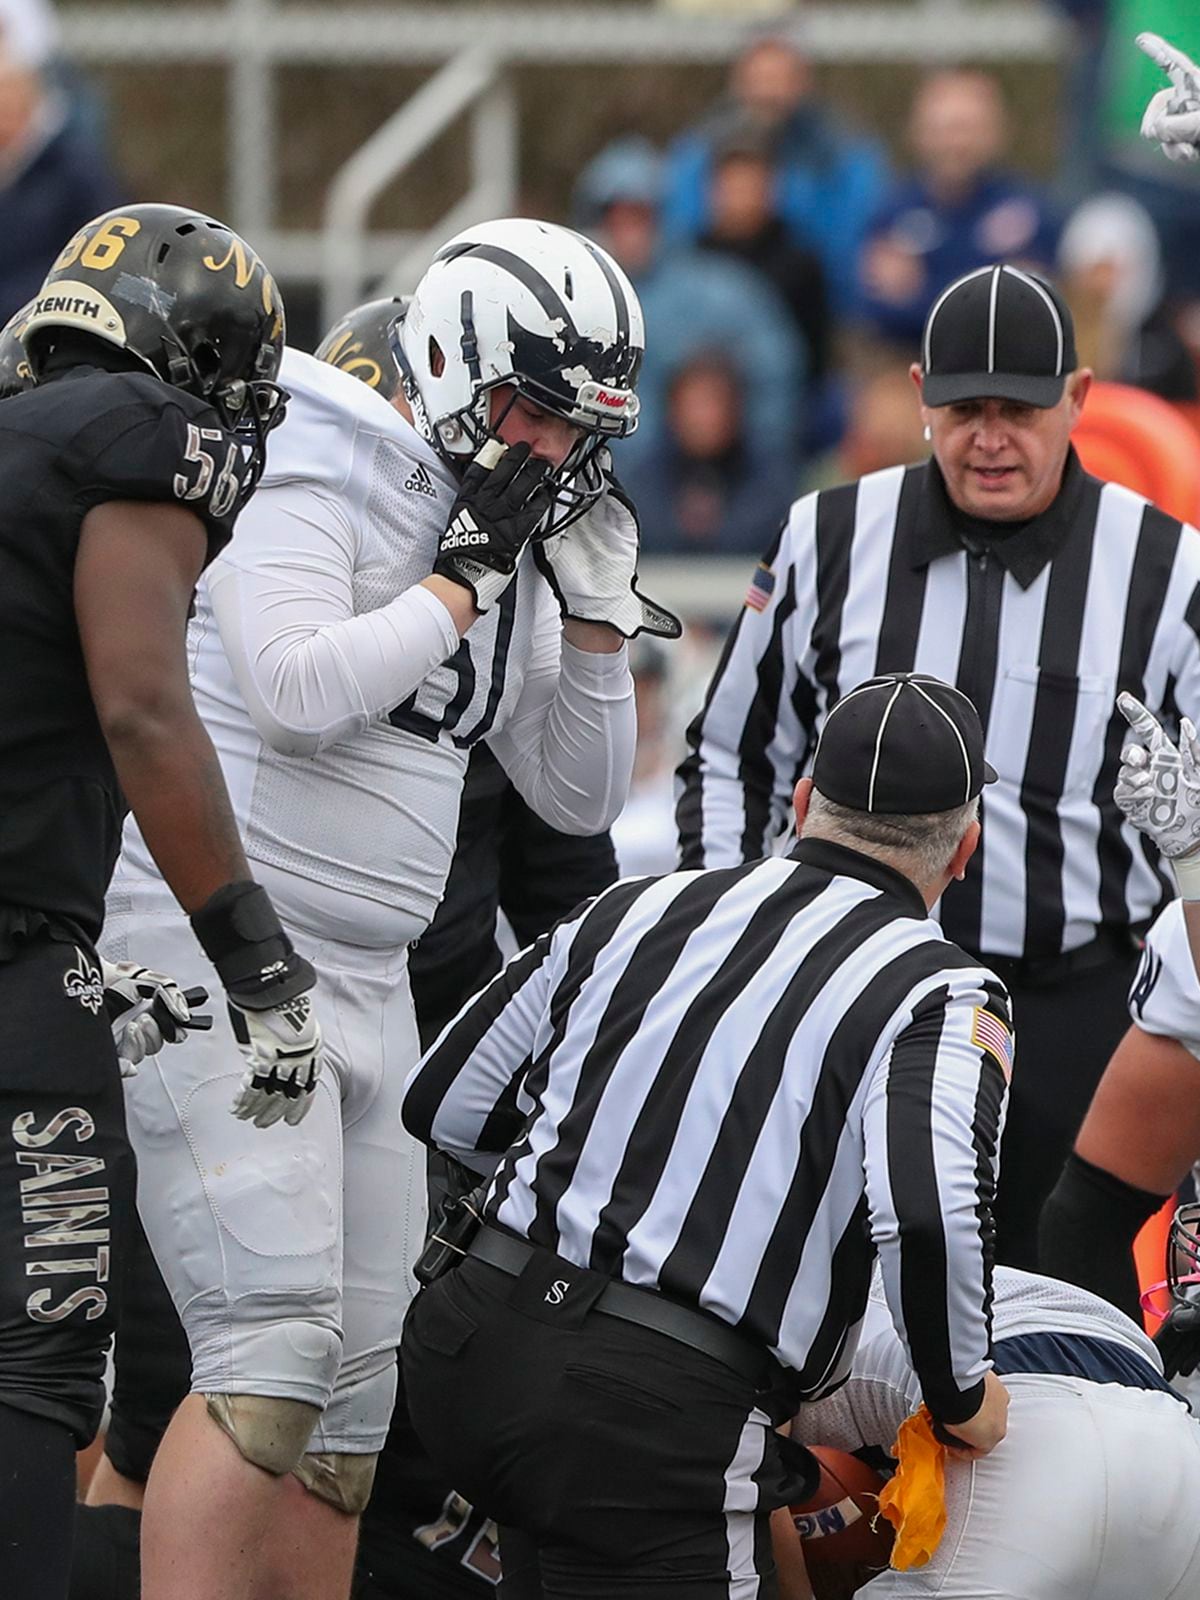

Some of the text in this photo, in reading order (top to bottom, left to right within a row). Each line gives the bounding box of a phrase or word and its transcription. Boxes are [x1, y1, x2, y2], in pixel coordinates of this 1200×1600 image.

[33, 296, 100, 319] XENITH
[173, 422, 239, 518] 56
[439, 531, 490, 552] adidas
[11, 1105, 112, 1325] SAINTS
